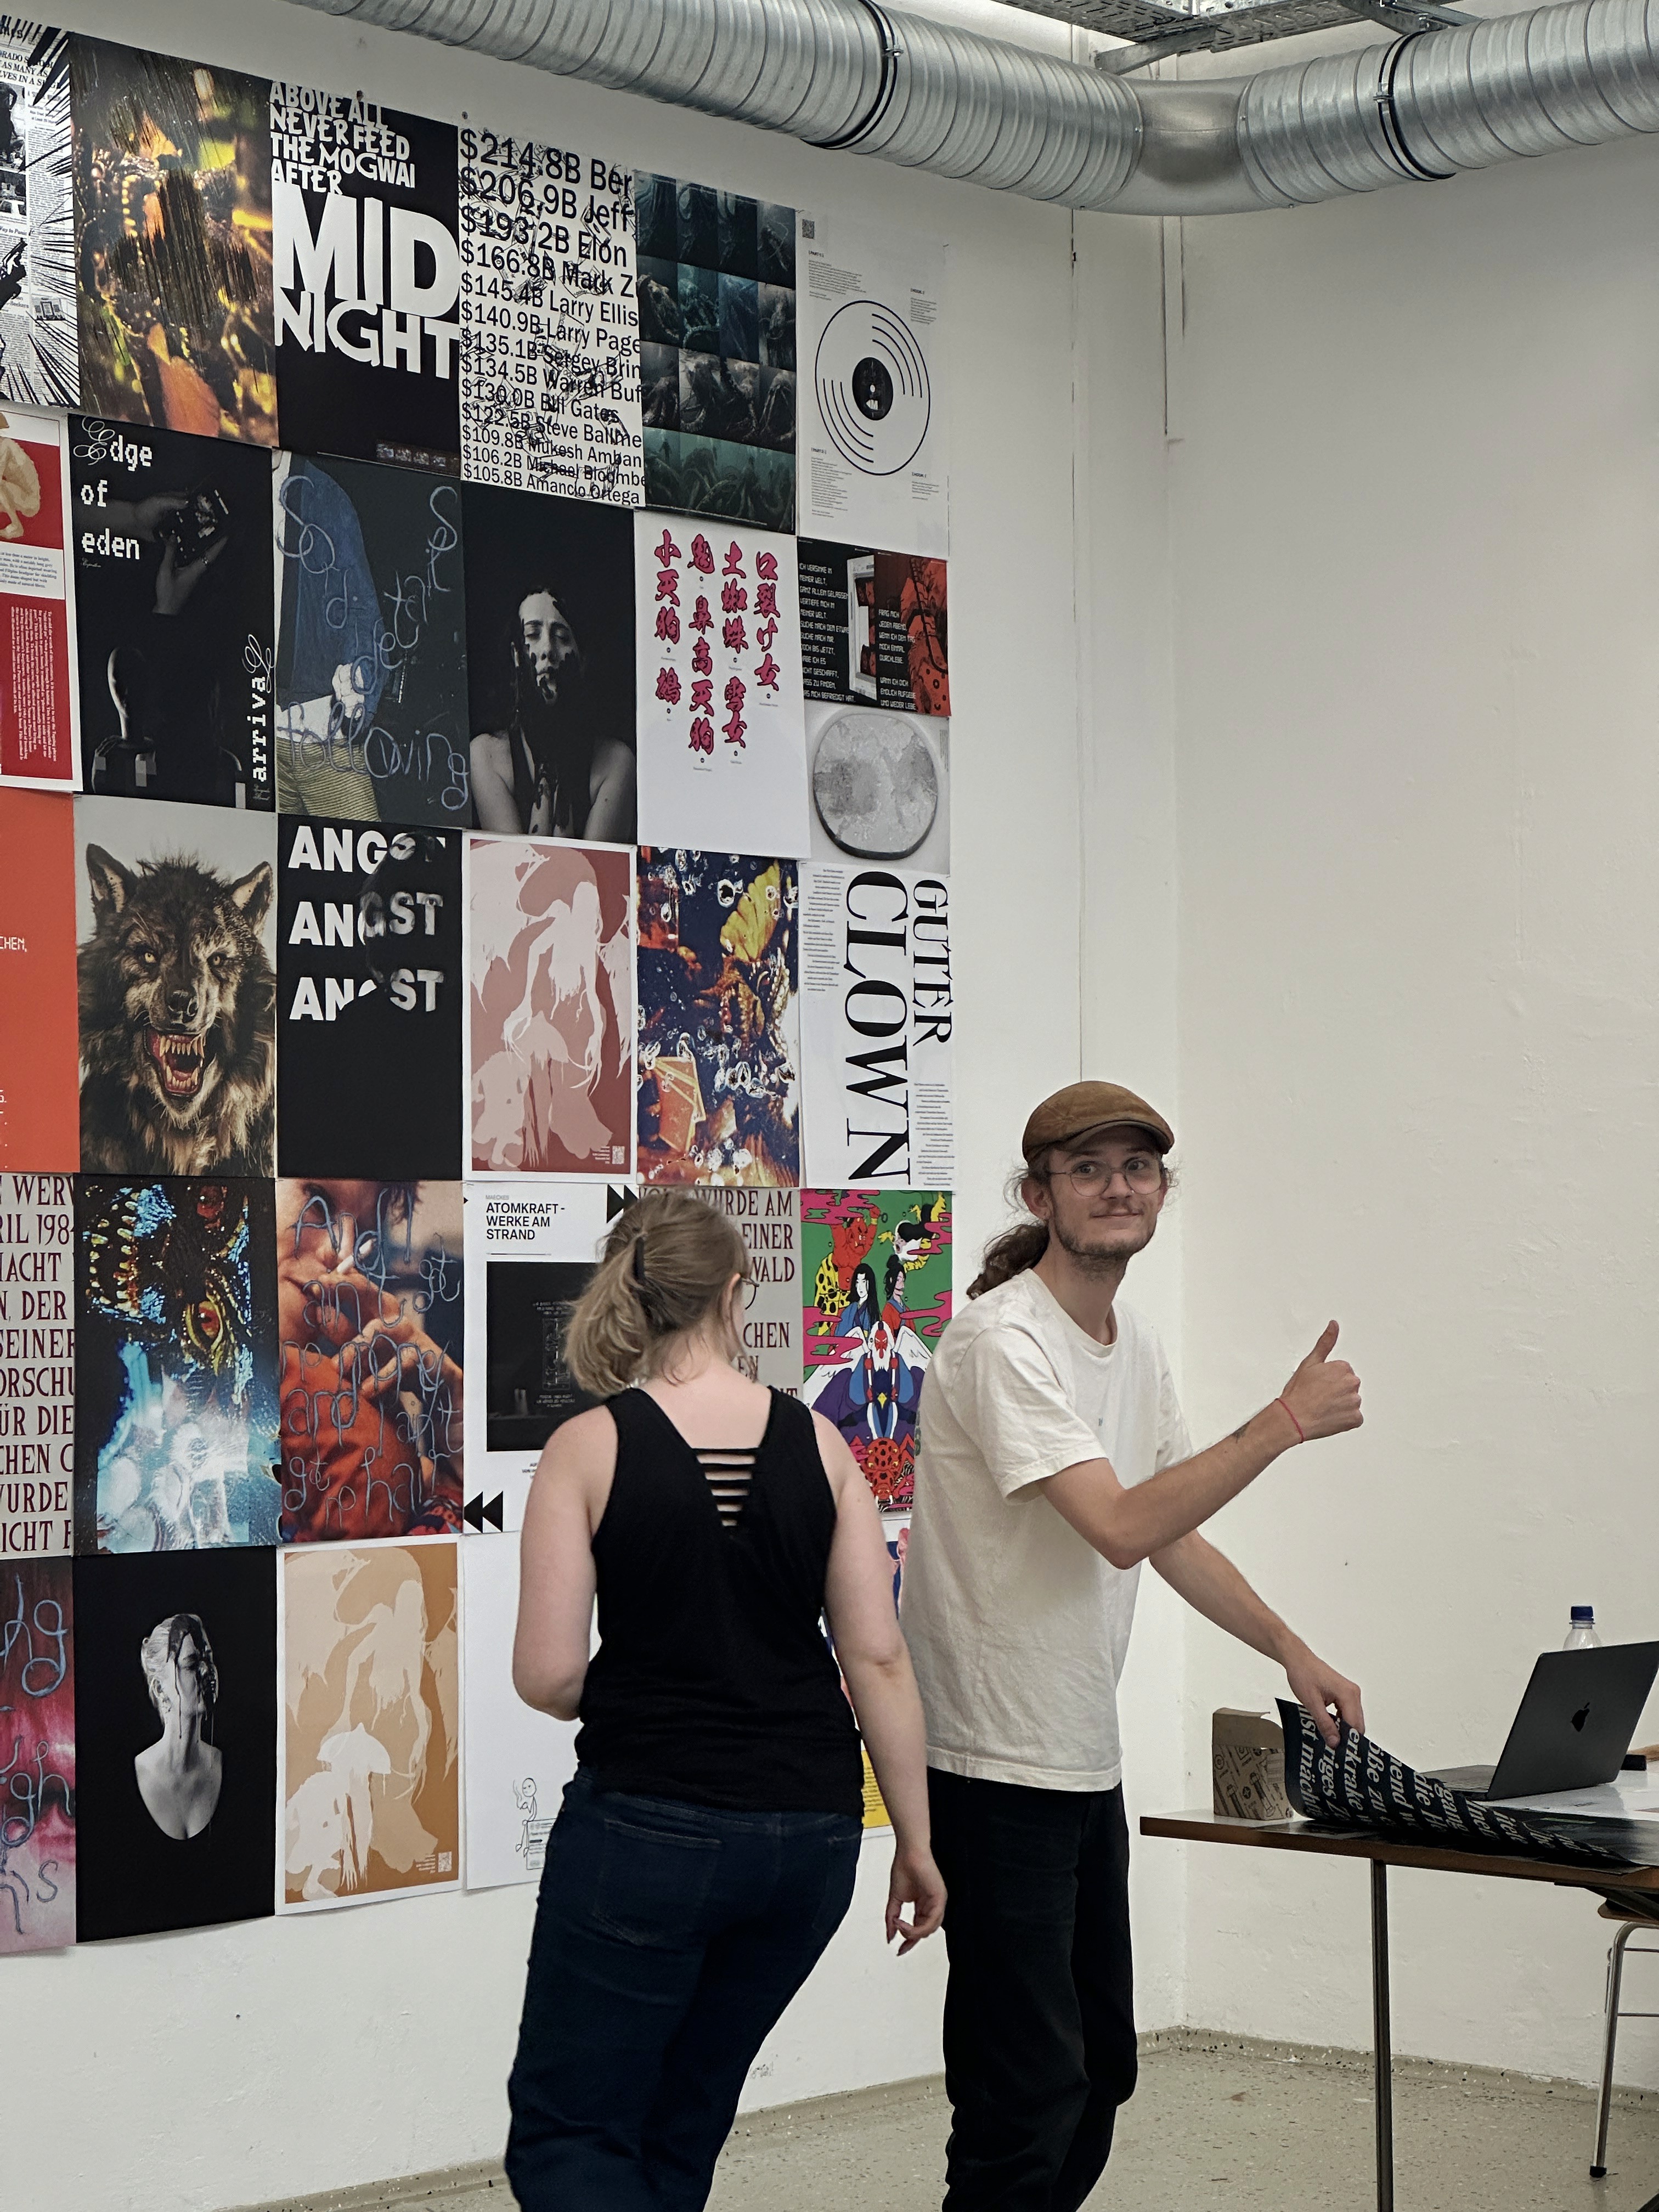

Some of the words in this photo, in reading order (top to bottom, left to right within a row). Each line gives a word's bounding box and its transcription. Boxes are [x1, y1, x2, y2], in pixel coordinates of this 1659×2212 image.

[14, 63, 36, 75] MANY
[270, 82, 345, 119] ABOVE
[348, 99, 390, 129] ALL
[270, 103, 349, 145] NEVER
[354, 124, 410, 160] FEED
[270, 131, 314, 163] THE
[319, 142, 415, 189] MOGWAI
[270, 158, 343, 195] AFTER
[460, 128, 581, 184] $214.8B
[590, 159, 632, 197] Ber
[583, 195, 634, 232] Jeff
[272, 183, 460, 318] MID
[578, 230, 627, 267] Elon
[461, 238, 555, 281] $166.8B
[562, 260, 614, 295] Mark
[620, 273, 635, 298] Z
[549, 290, 594, 323] Larry
[600, 301, 639, 327] Ellis
[274, 287, 460, 380] NIGHT
[461, 299, 540, 335] $140.9B
[548, 318, 590, 349] Larry
[596, 328, 640, 357] Page
[461, 325, 539, 360] $135.1B
[543, 345, 600, 376] Sergey
[461, 353, 538, 385] $134.5B
[461, 402, 531, 430] $122.5B
[537, 414, 578, 439] Steve
[571, 399, 619, 424] Gates
[73, 416, 153, 472] Edge
[461, 425, 524, 450] $109.8B
[528, 440, 583, 461] Mukesh
[462, 444, 522, 469] $106.2B
[81, 479, 108, 507] of
[463, 463, 523, 487] $105.8B
[526, 473, 586, 498] Amancio
[591, 484, 640, 506] Ortega
[82, 528, 140, 560] eden
[753, 551, 781, 691] 口裂け女
[721, 676, 747, 749] 雪女
[912, 879, 953, 1046] GUTER
[844, 870, 911, 1186] CLOWN
[486, 1216, 529, 1227] WERKE
[532, 1216, 550, 1227] AM
[765, 1190, 793, 1217] AM
[36, 1214, 74, 1245] 198
[286, 1188, 390, 1274] And
[486, 1229, 535, 1240] STRAND
[0, 1252, 62, 1282] ACHT
[21, 1290, 67, 1320] DER
[743, 1322, 790, 1348] CHEN
[37, 1405, 74, 1436] DIE
[0, 1481, 68, 1513] URDE
[1414, 1771, 1434, 1806] die
